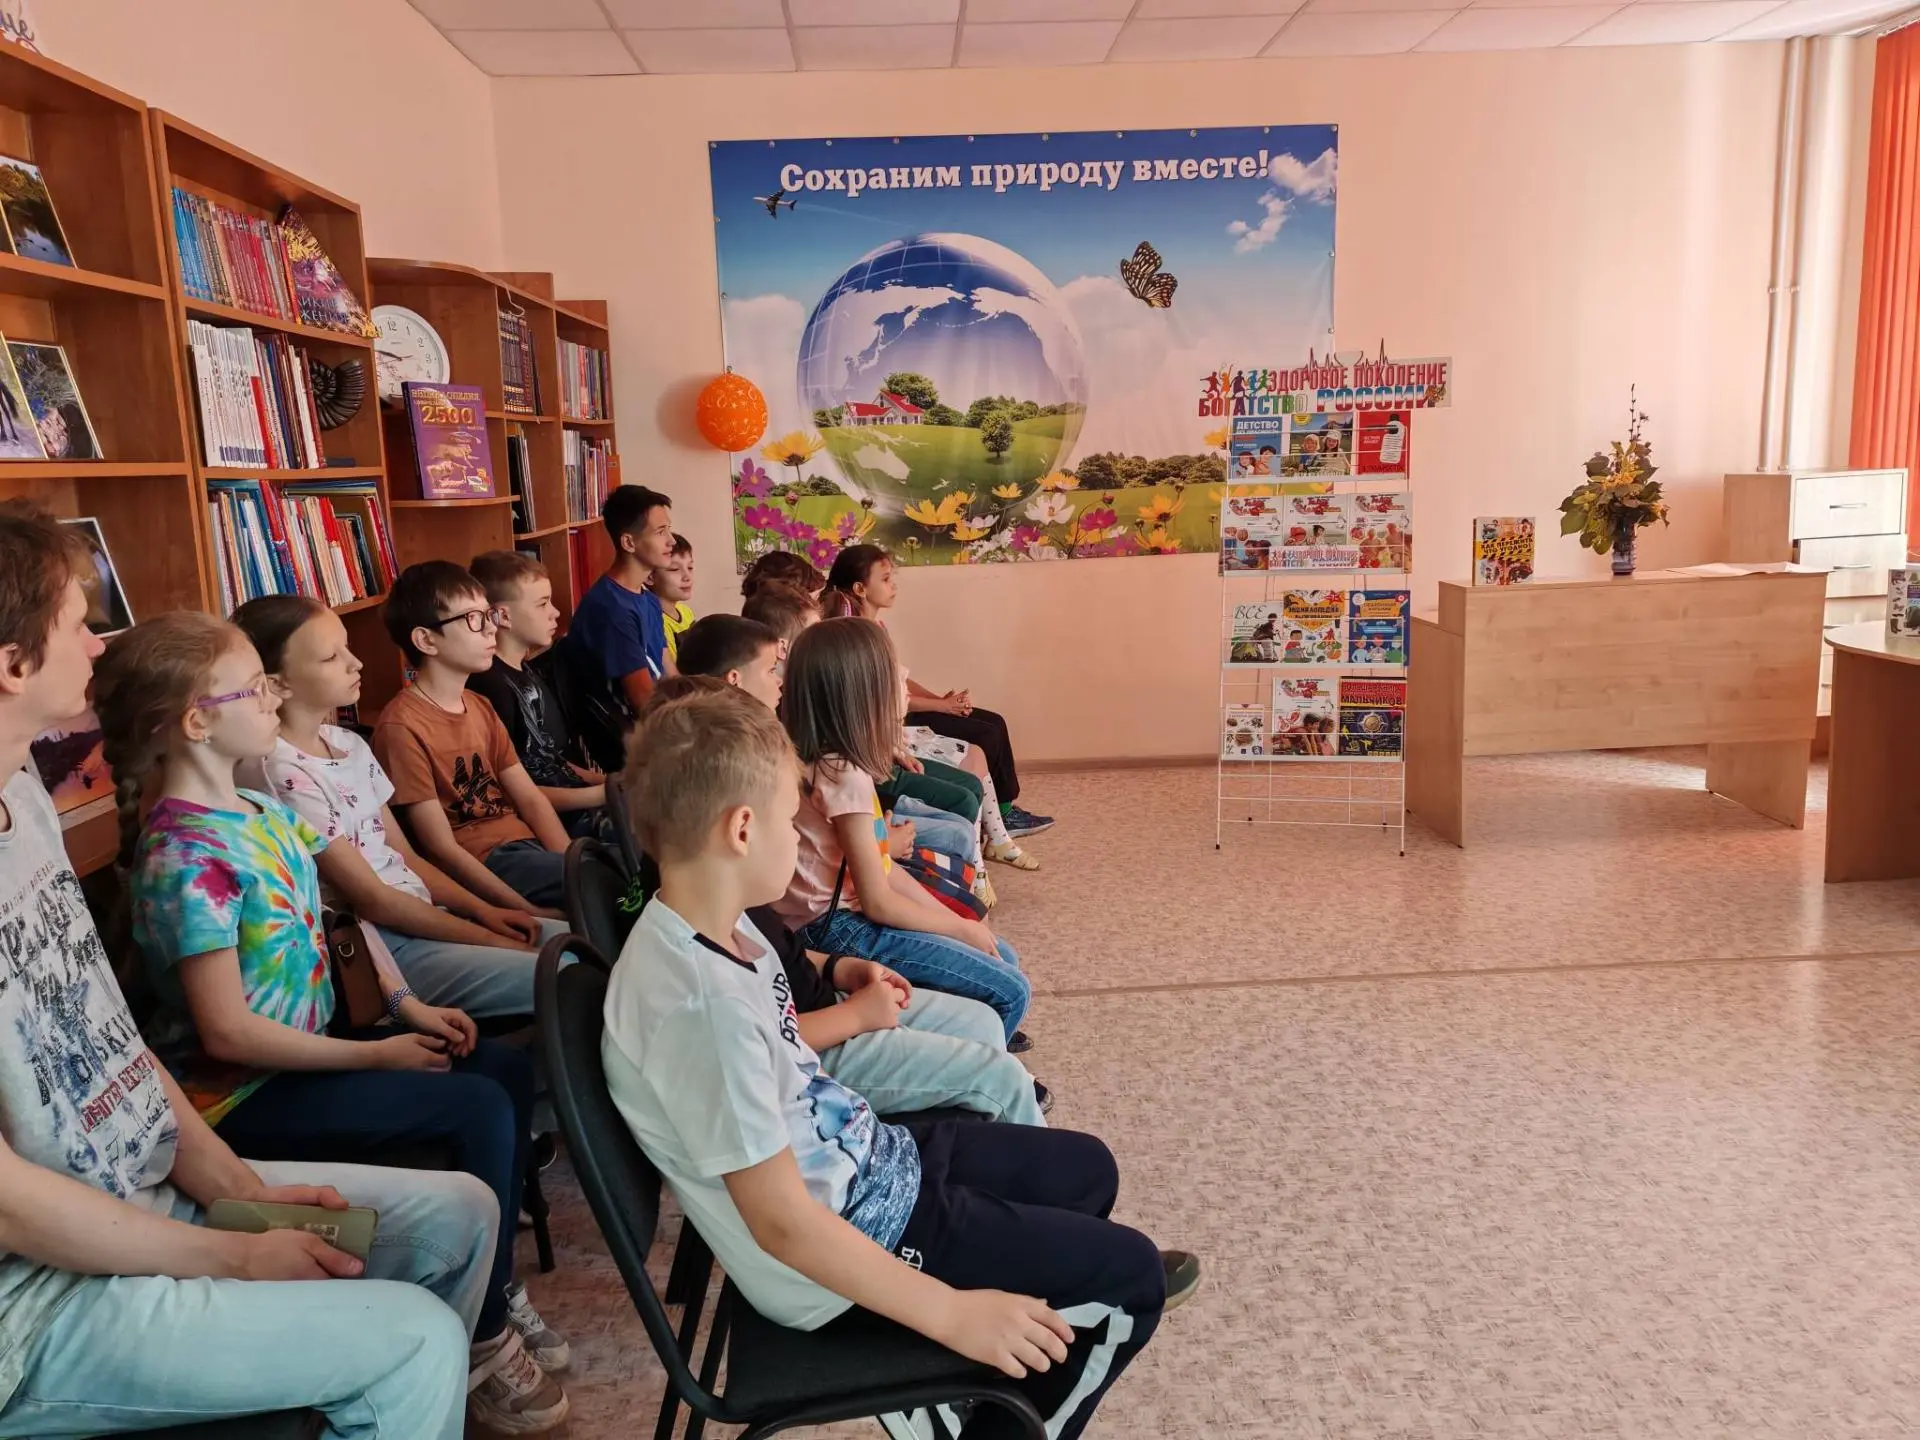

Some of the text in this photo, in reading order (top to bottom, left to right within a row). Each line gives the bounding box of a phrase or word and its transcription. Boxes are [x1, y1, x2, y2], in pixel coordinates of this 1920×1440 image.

[780, 149, 1270, 199] Сохраним природу вместе!
[387, 320, 397, 331] 12
[417, 336, 424, 348] 2
[425, 353, 431, 364] 3
[1267, 362, 1448, 394] ЗДОРОВОЕ ПОКОЛЕНИЕ
[422, 405, 474, 425] 2500
[1236, 420, 1279, 430] ДЕТСТВО
[1234, 604, 1267, 620] ВСЕ
[1342, 695, 1402, 705] МАЛЬЧИКОВ
